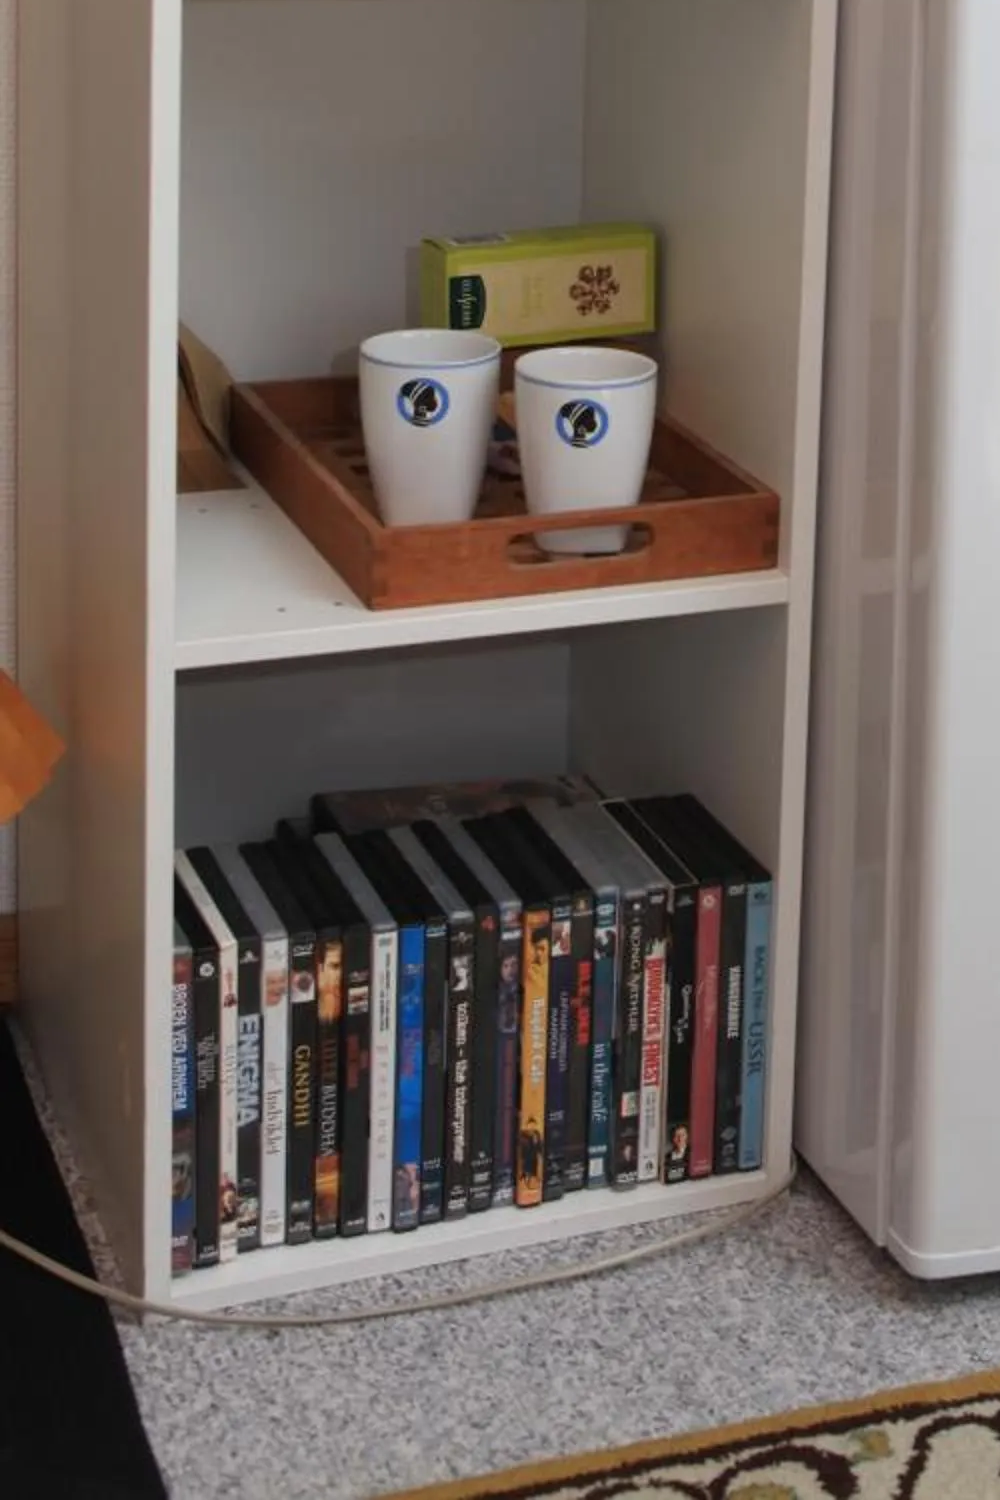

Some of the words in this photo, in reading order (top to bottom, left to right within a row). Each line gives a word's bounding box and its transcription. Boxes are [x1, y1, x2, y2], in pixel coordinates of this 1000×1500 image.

[628, 924, 641, 970] KONG
[172, 983, 187, 1025] BROEN
[172, 1028, 186, 1053] VED
[745, 1020, 764, 1078] USSR
[172, 1056, 187, 1111] ARNHEM
[236, 1012, 259, 1126] ENIGMA
[292, 1044, 311, 1127] GANDHI
[455, 1059, 467, 1083] the
[592, 1062, 608, 1087] the
[320, 1083, 337, 1156] BUDDHA
